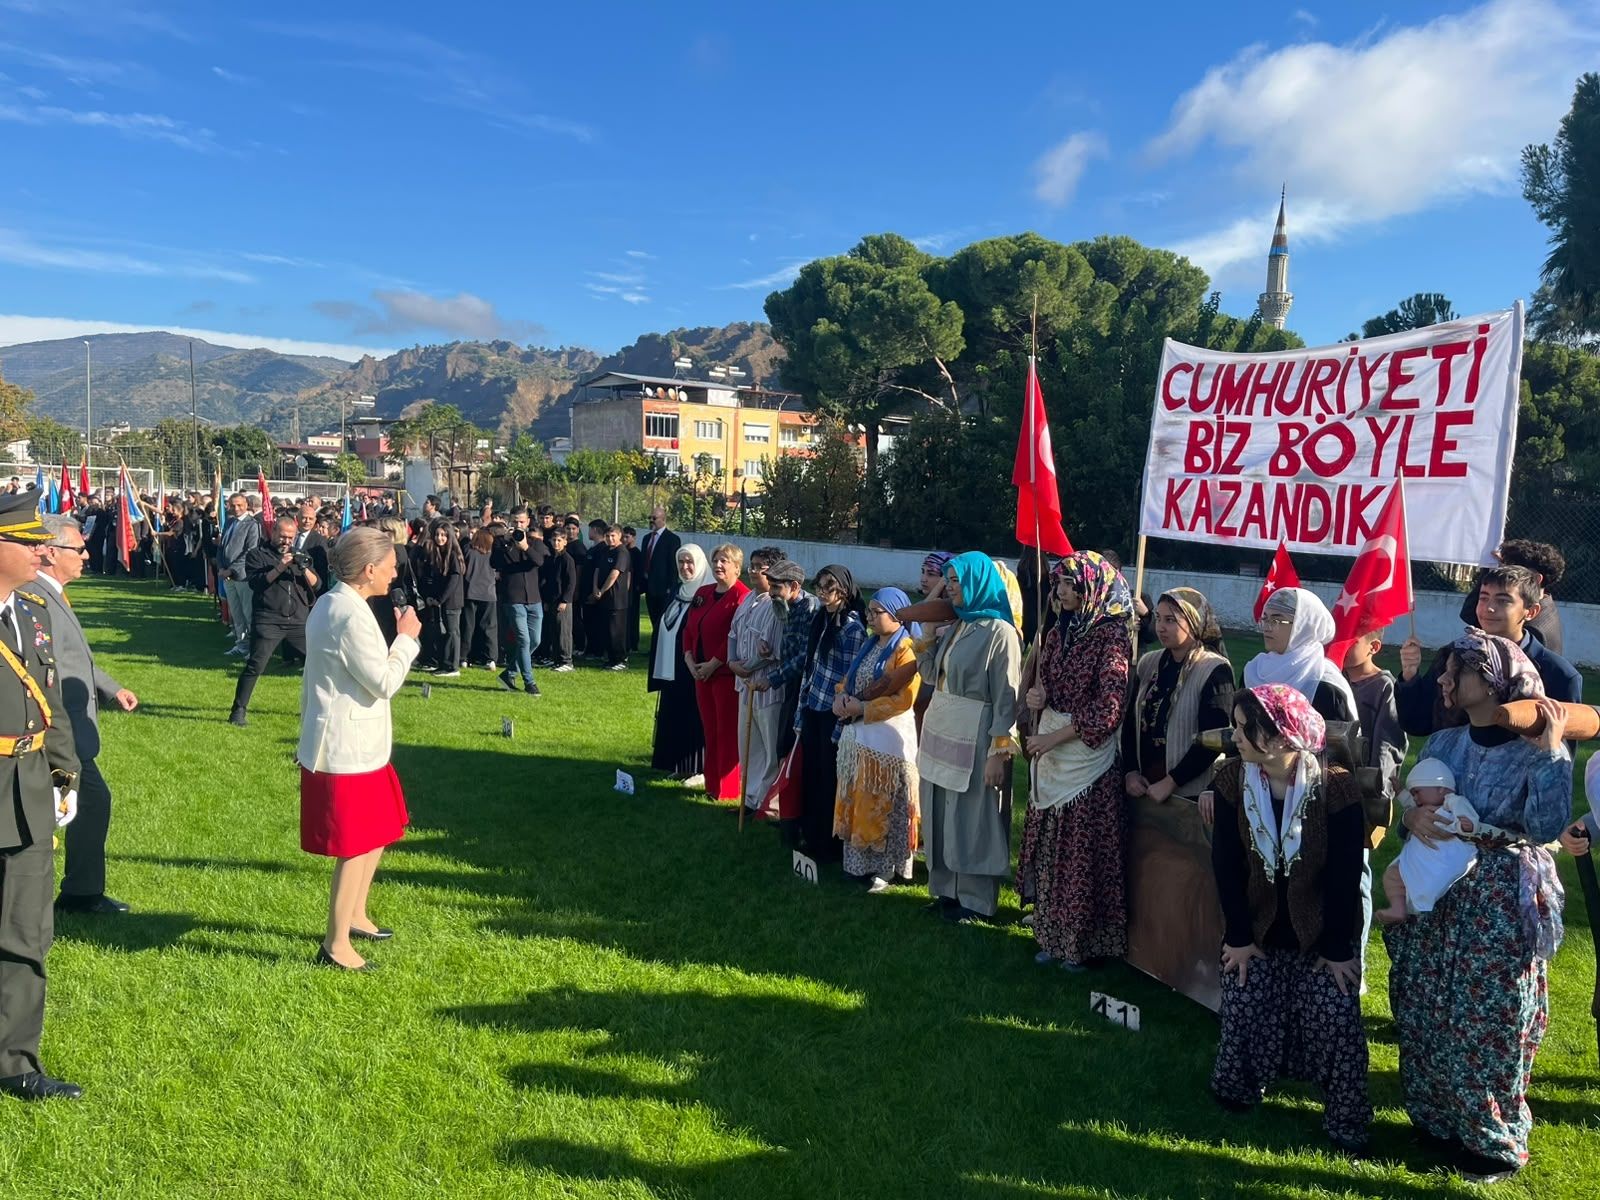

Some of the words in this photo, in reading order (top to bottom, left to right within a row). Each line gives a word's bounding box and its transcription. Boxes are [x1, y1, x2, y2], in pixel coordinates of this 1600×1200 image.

[1162, 324, 1490, 416] CUMHURİYETİ
[1184, 414, 1252, 475] BİZ
[1268, 410, 1474, 478] BÖYLE
[1162, 478, 1387, 546] KAZANDIK
[794, 859, 814, 882] 40
